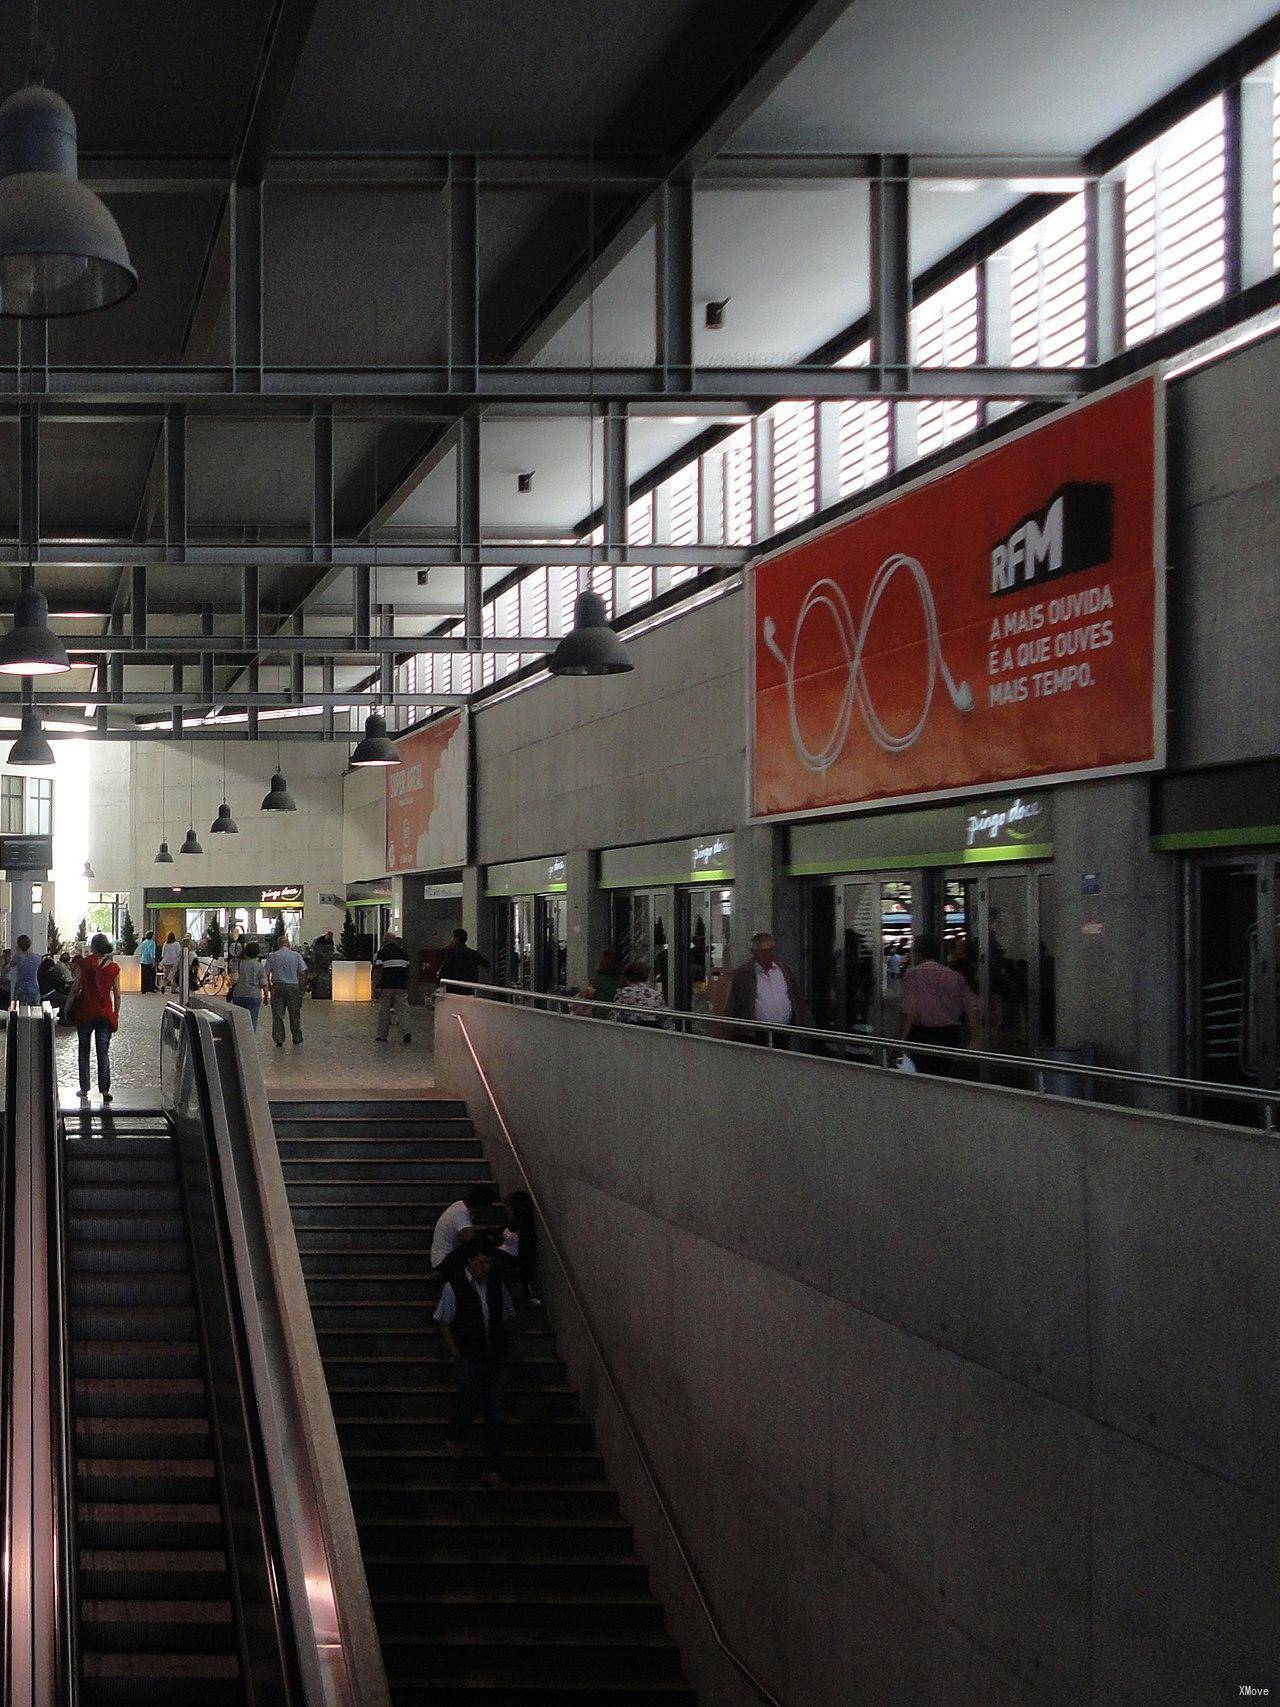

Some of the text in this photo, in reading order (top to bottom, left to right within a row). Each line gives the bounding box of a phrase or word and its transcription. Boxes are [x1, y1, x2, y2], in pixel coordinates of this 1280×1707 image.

[991, 496, 1064, 594] RFM
[989, 584, 1114, 641] A MAIS OUVIDA
[988, 619, 1114, 675] É A QUE OUVES
[988, 662, 1096, 707] MAIS TEMPO.
